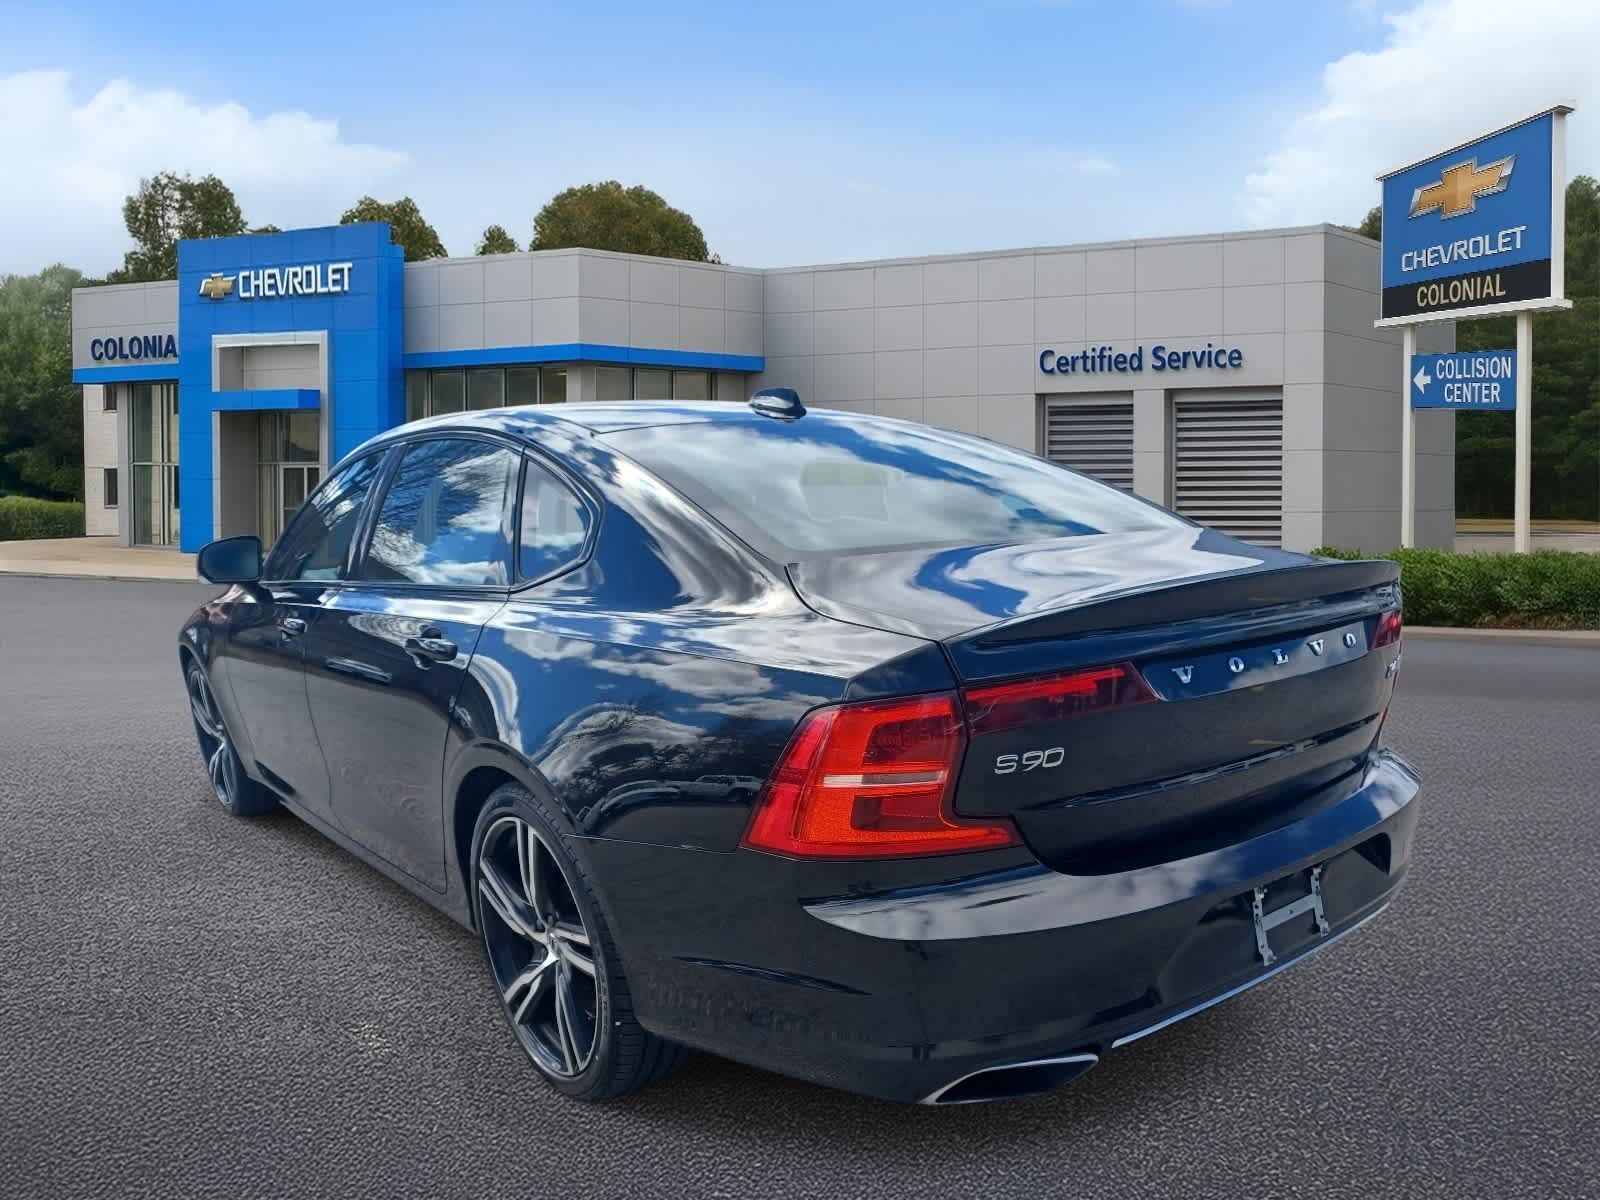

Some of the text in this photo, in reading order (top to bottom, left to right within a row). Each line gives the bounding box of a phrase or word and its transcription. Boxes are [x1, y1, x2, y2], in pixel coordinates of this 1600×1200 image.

[1401, 225, 1527, 273] CHEVROLET
[238, 261, 353, 298] CHEVROLET
[1416, 273, 1506, 308] COLONIAL
[1039, 343, 1243, 375] Certified Service
[1435, 356, 1512, 380] COLLISION
[1443, 382, 1501, 404] CENTER
[1171, 632, 1357, 685] VOLVO
[994, 746, 1065, 775] S90
